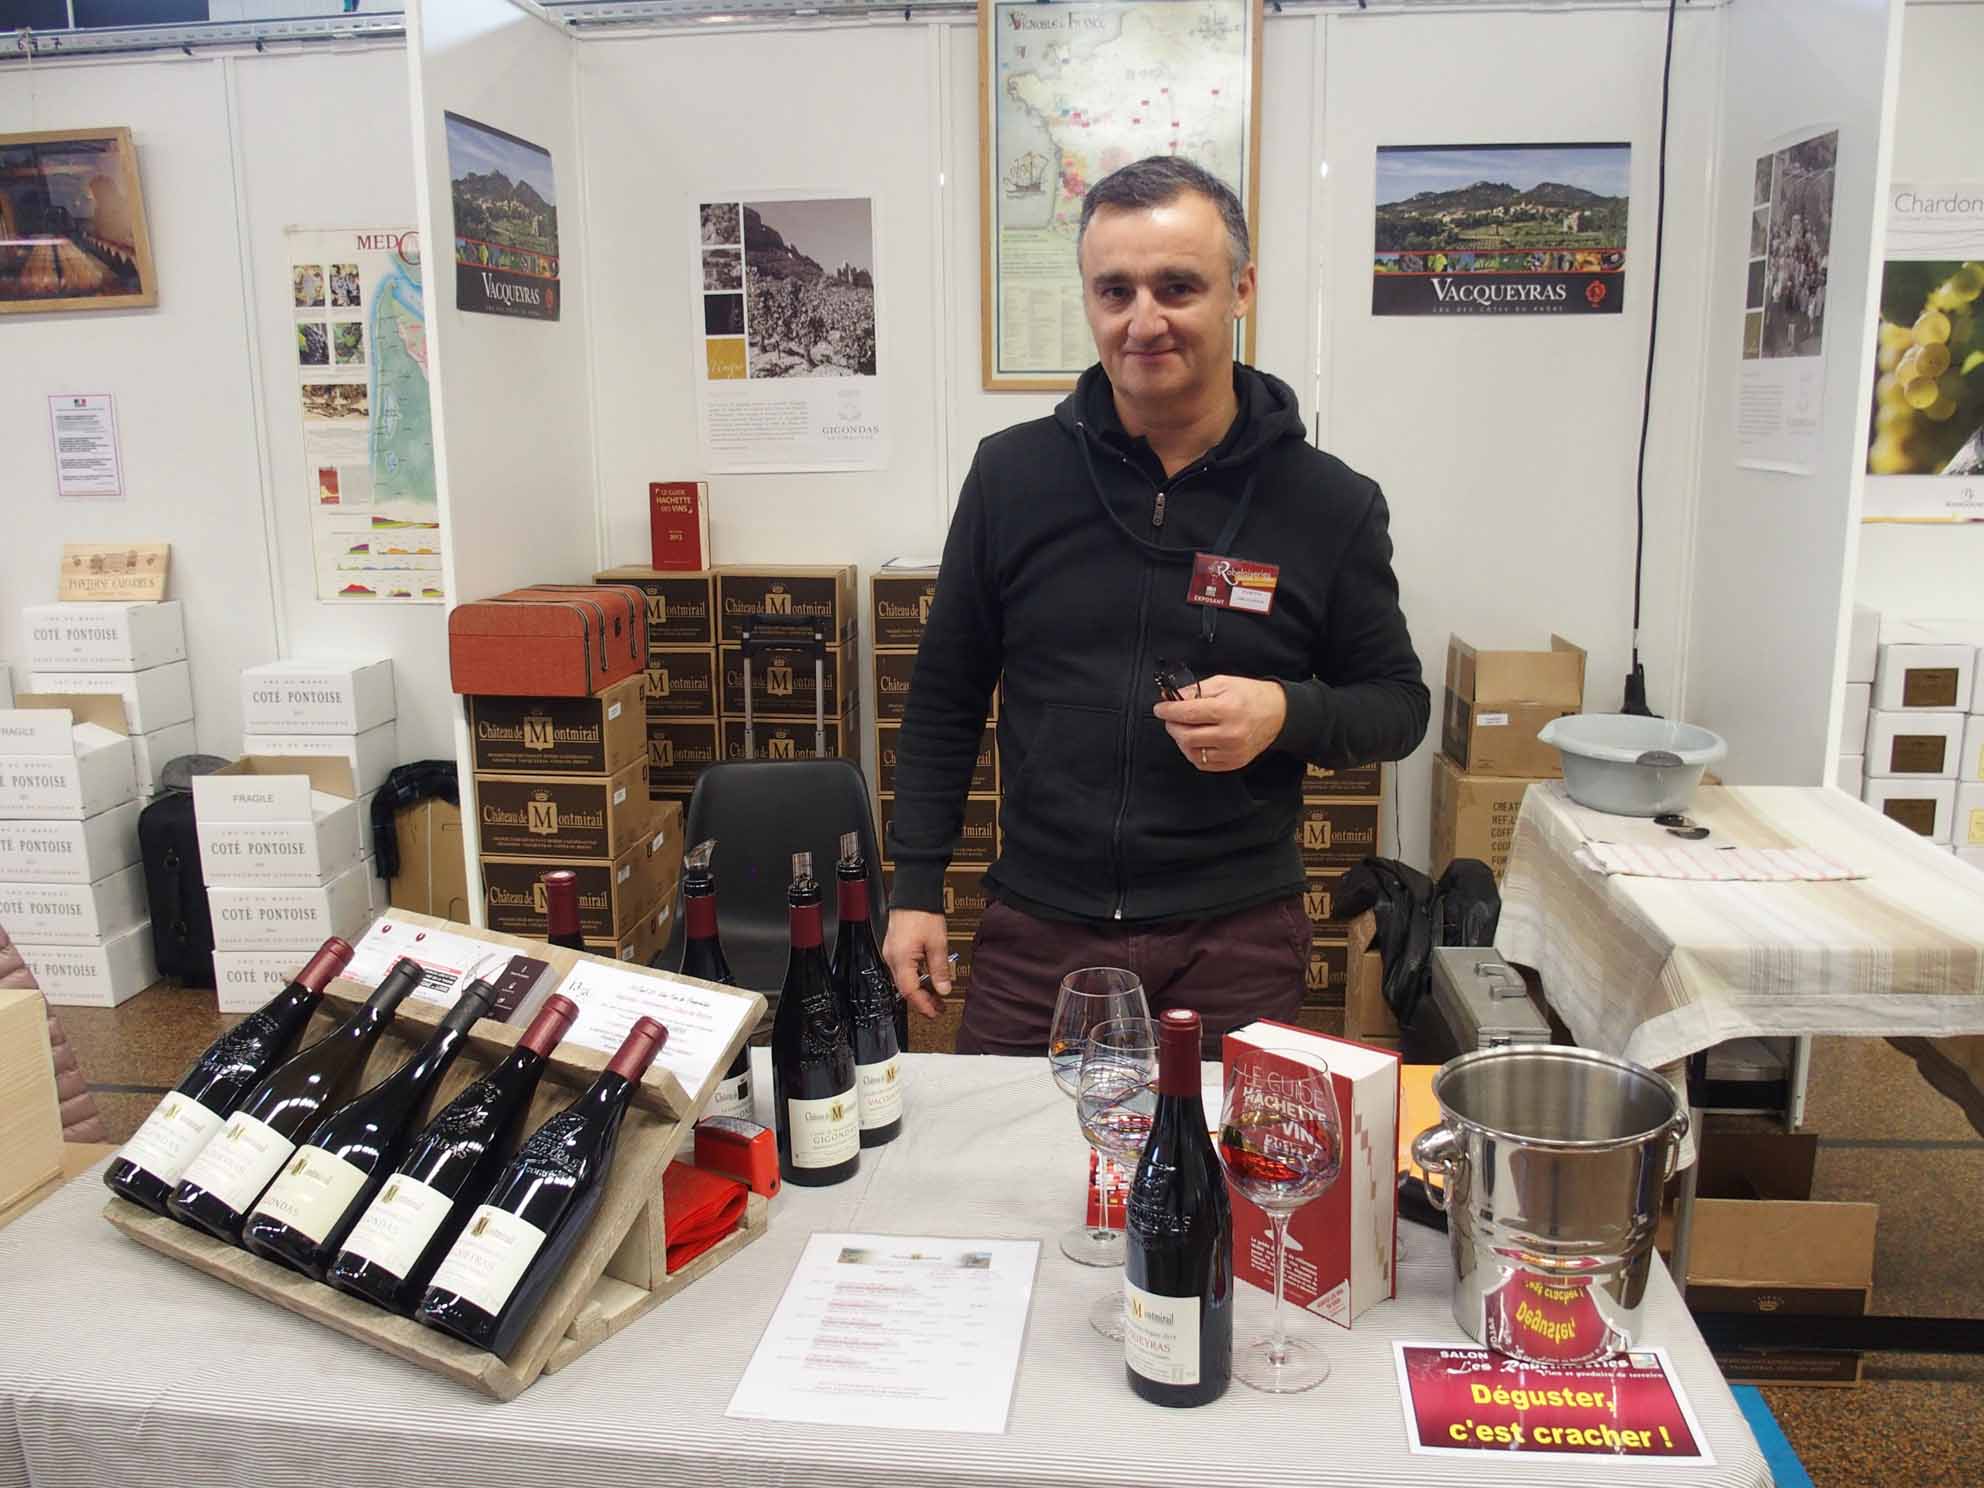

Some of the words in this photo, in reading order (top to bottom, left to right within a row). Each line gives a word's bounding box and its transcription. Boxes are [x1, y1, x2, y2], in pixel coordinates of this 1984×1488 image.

[1894, 191, 1984, 213] Chardon
[481, 271, 541, 306] VACQUEYRAS
[1430, 278, 1567, 306] VACQUEYRAS
[822, 424, 880, 435] GIGONDAS
[656, 496, 692, 504] HACHETTE
[1193, 594, 1225, 606] EXPOSANT
[878, 600, 909, 617] Château
[66, 628, 119, 641] PONTOISE
[288, 691, 343, 704] PONTOISE
[478, 721, 512, 740] Château
[528, 721, 600, 744] Montmirail
[12, 775, 67, 789] PONTOISE
[232, 794, 274, 804] FRAGILE
[483, 804, 516, 824] Château
[532, 804, 604, 828] Montmirail
[1308, 823, 1374, 845] Montmirail
[20, 840, 73, 853] PONTOISE
[248, 842, 306, 855] PONTOISE
[490, 884, 521, 906] Château
[30, 902, 83, 916] PONTOISE
[259, 907, 318, 921] PONTOISE
[46, 964, 97, 977] PONTOISE
[1267, 1071, 1325, 1111] GUIDE
[1440, 1350, 1489, 1360] SALON
[1470, 1383, 1616, 1413] Déguster,
[1448, 1419, 1525, 1444] c'est
[1533, 1422, 1652, 1448] cracher
[1660, 1425, 1674, 1448] !
